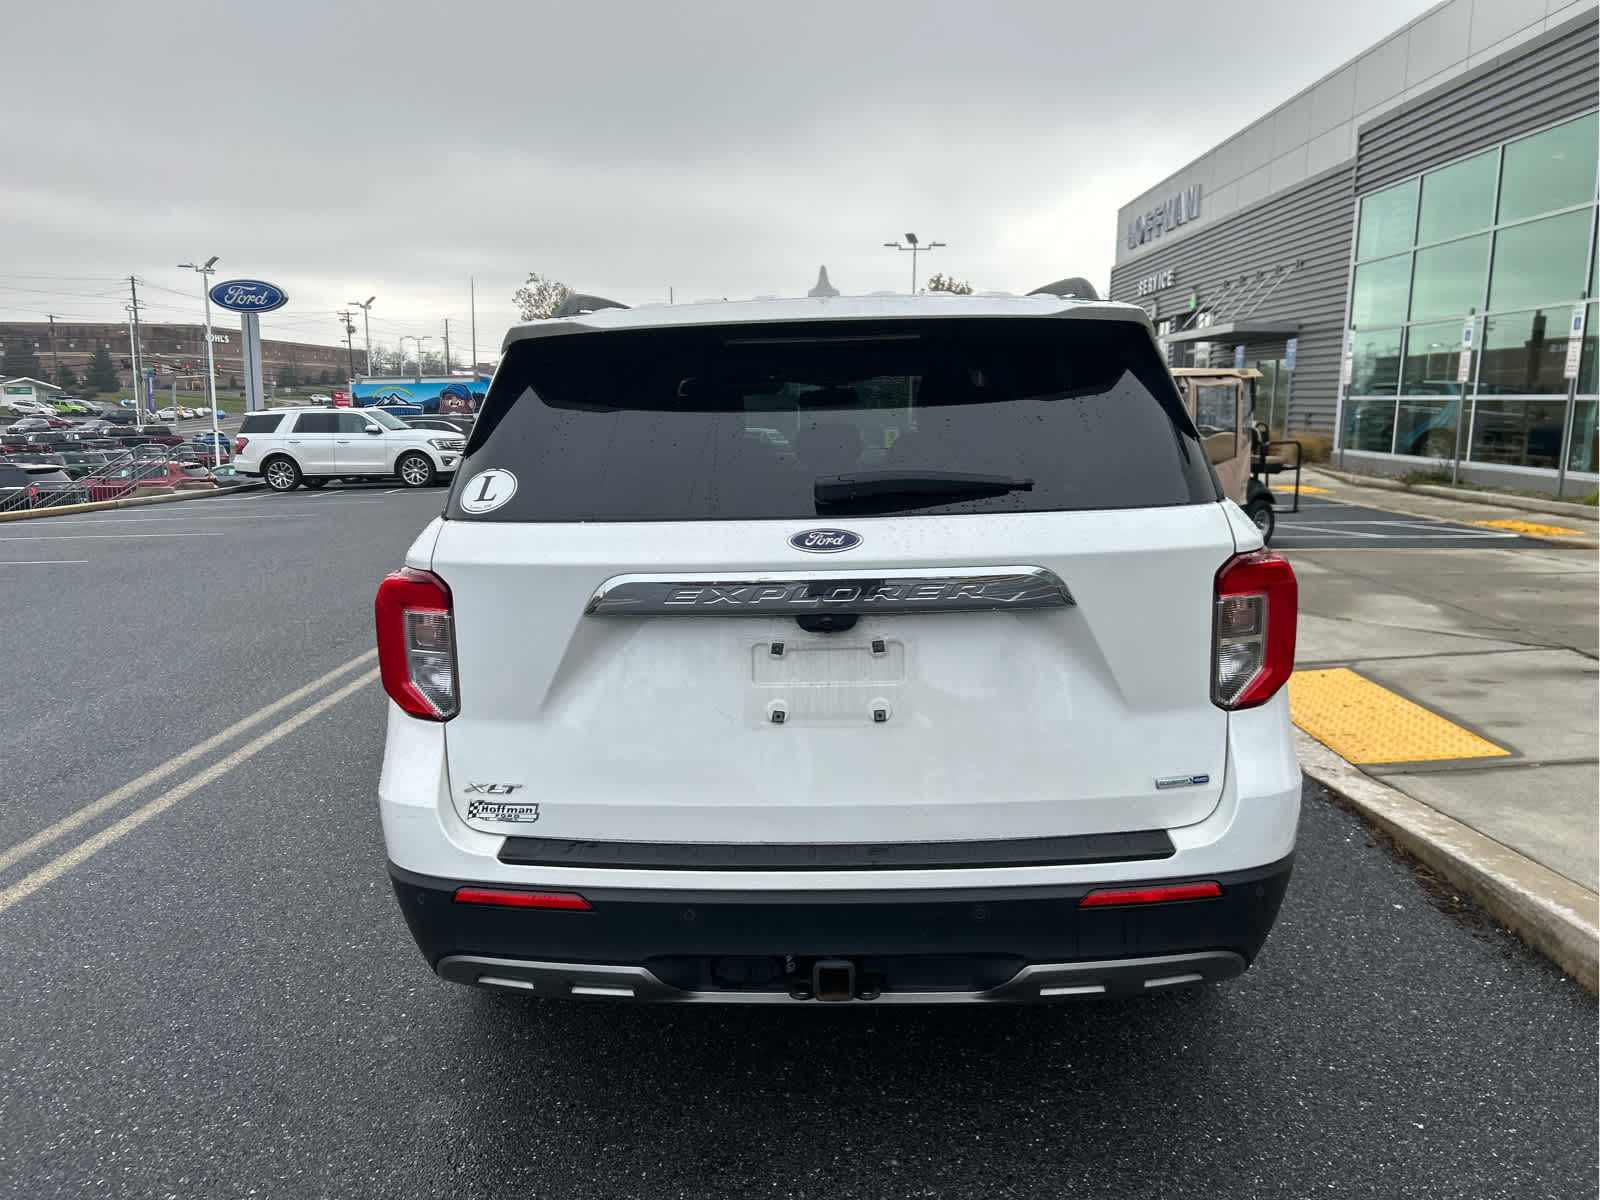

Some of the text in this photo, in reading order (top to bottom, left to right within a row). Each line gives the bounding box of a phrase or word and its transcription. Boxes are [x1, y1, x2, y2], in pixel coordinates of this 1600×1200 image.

[1137, 269, 1176, 297] SERVICE
[224, 285, 268, 304] Ford
[472, 475, 497, 502] L
[805, 531, 846, 546] Ford
[664, 581, 990, 605] EXPLORER
[464, 783, 523, 794] XLT
[481, 804, 533, 814] Hoffman
